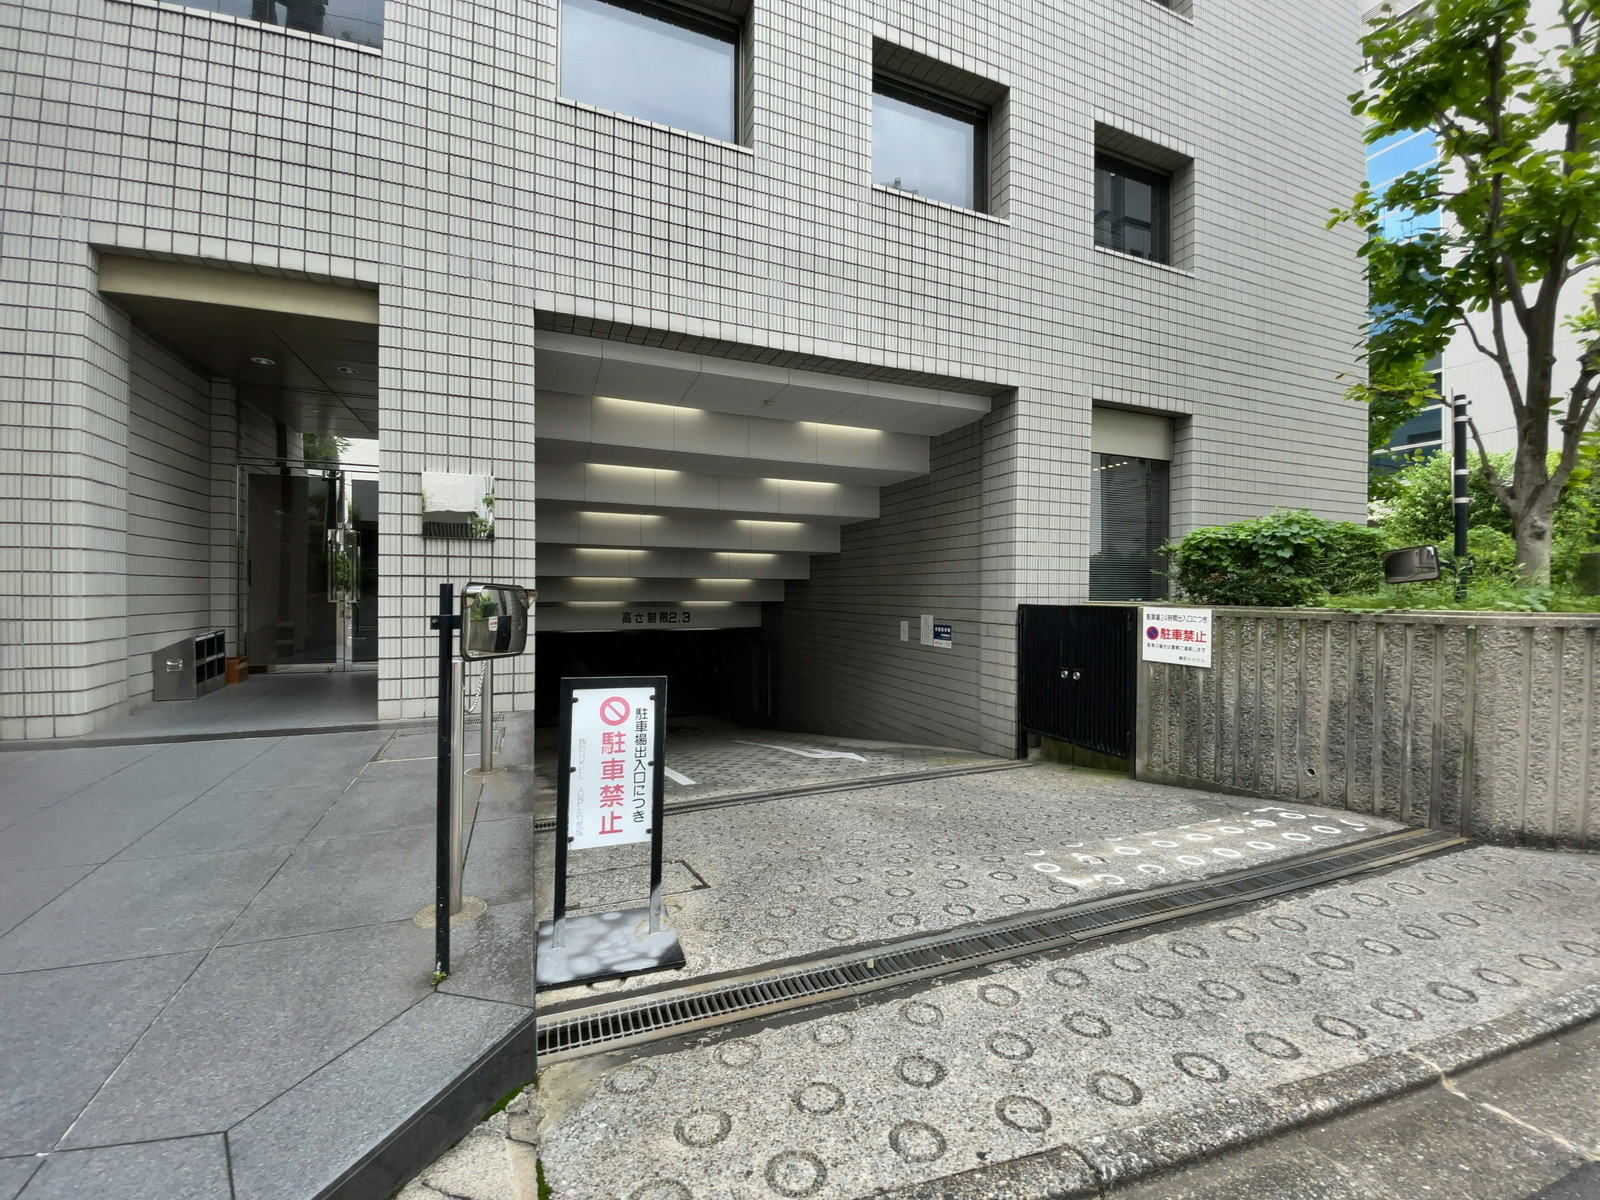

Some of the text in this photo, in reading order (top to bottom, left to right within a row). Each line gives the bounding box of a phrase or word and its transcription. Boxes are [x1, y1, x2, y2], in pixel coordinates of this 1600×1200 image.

[621, 612, 691, 624] 高さ制限2.3
[1160, 628, 1207, 643] 駐車禁止
[599, 731, 626, 835] 駐車禁止
[632, 707, 648, 823] 駐車場出入口につき
